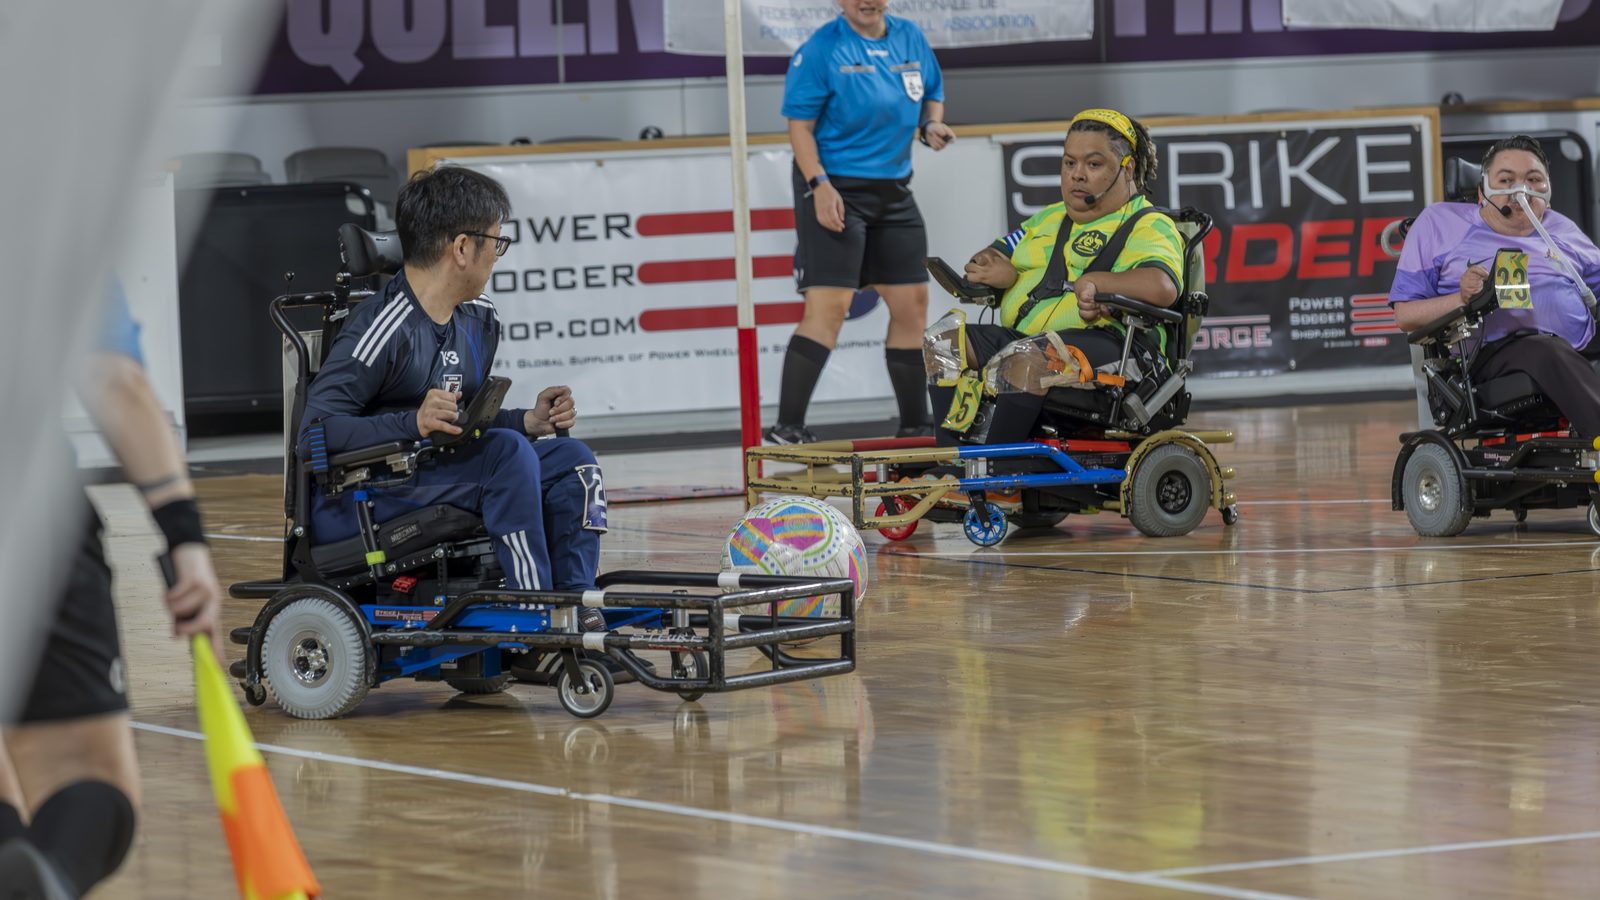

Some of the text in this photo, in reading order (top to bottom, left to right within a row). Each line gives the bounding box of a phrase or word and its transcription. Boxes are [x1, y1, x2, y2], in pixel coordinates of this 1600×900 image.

[1011, 133, 1415, 217] SRIKE
[500, 213, 633, 244] OWER
[491, 264, 635, 294] OCCER
[1497, 267, 1528, 301] 23
[1289, 296, 1345, 311] POWER
[500, 316, 636, 341] OP.COM
[1192, 325, 1273, 350] ORCE
[955, 391, 973, 424] 5
